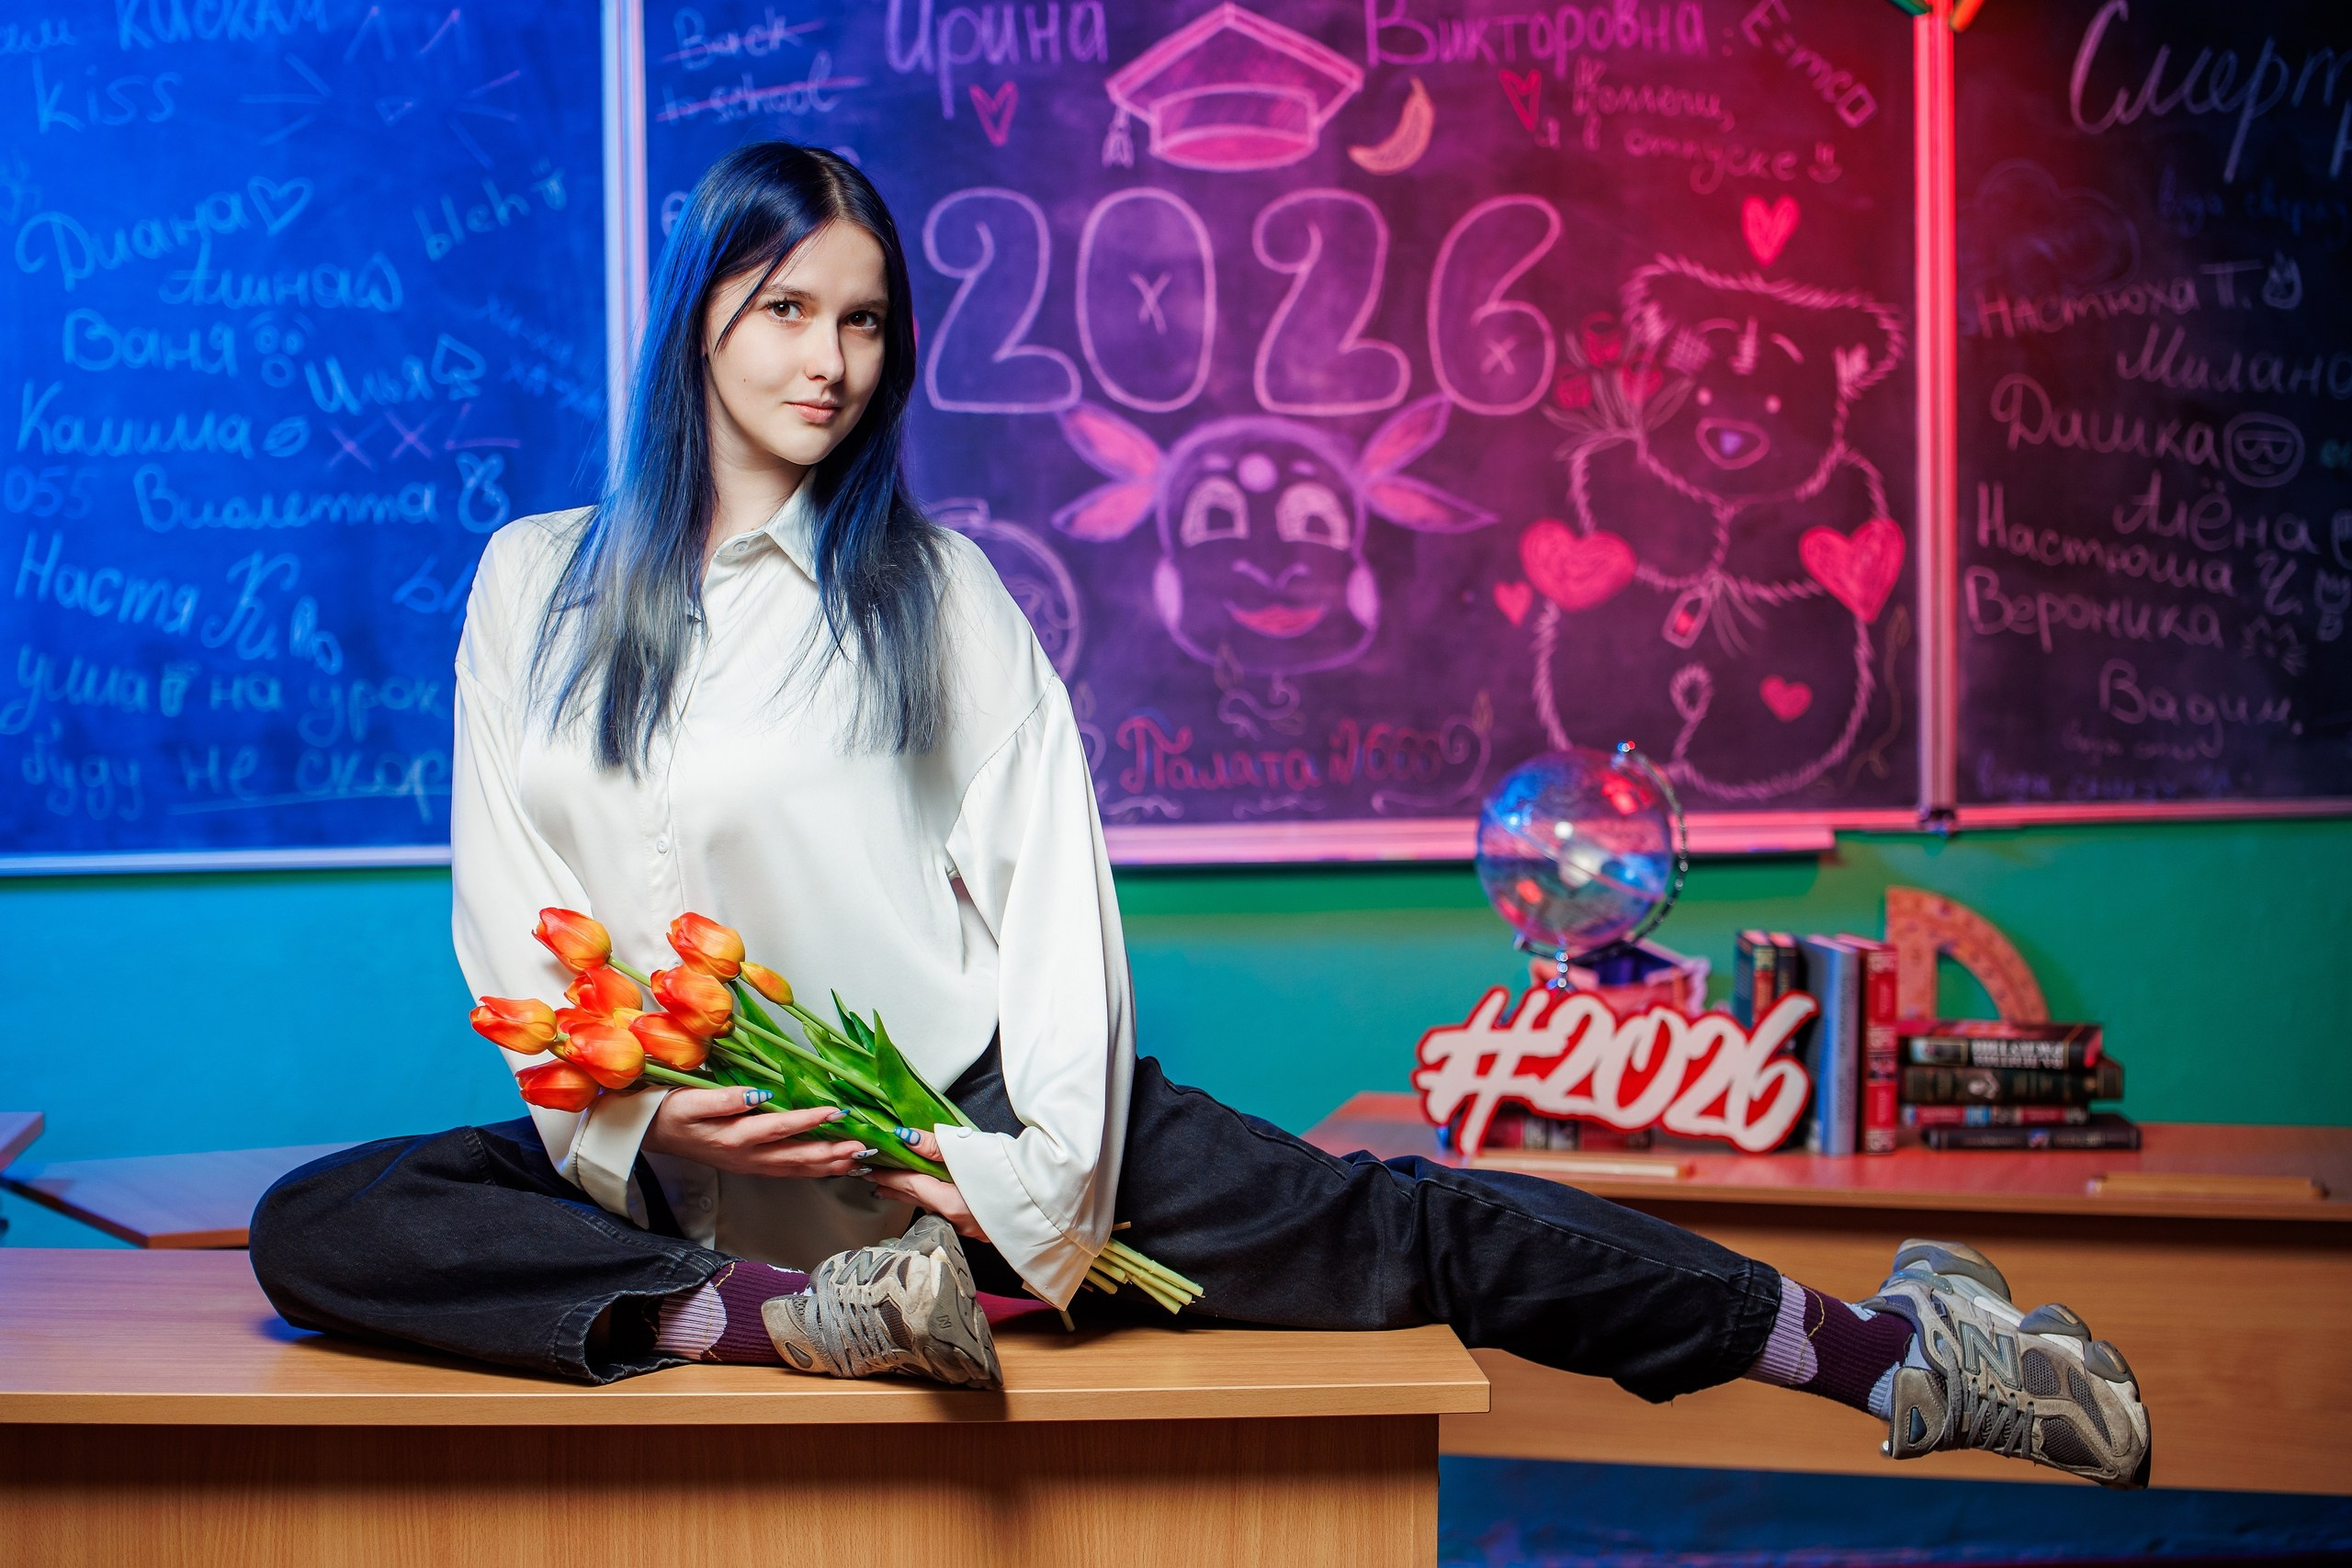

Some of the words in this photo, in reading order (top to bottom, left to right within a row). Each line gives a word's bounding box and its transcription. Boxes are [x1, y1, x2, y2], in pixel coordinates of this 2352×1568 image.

[673, 6, 805, 72] Back
[884, 0, 1108, 120] Ирина
[709, 49, 842, 126] school
[15, 192, 254, 292] Диана
[158, 239, 353, 310] Алина
[64, 308, 240, 378] Ваня
[922, 186, 1562, 416] 2026
[1989, 372, 2223, 469] Дашка
[133, 462, 439, 534] Виолетта
[2113, 469, 2321, 554] Алёна
[14, 530, 201, 638] Настя
[1963, 564, 2225, 654] Вероника
[210, 671, 285, 714] на
[299, 678, 447, 748] урок
[1115, 709, 1323, 794] Палата
[21, 716, 144, 822] буду
[181, 745, 261, 803] не
[1416, 986, 1819, 1156] #2026
